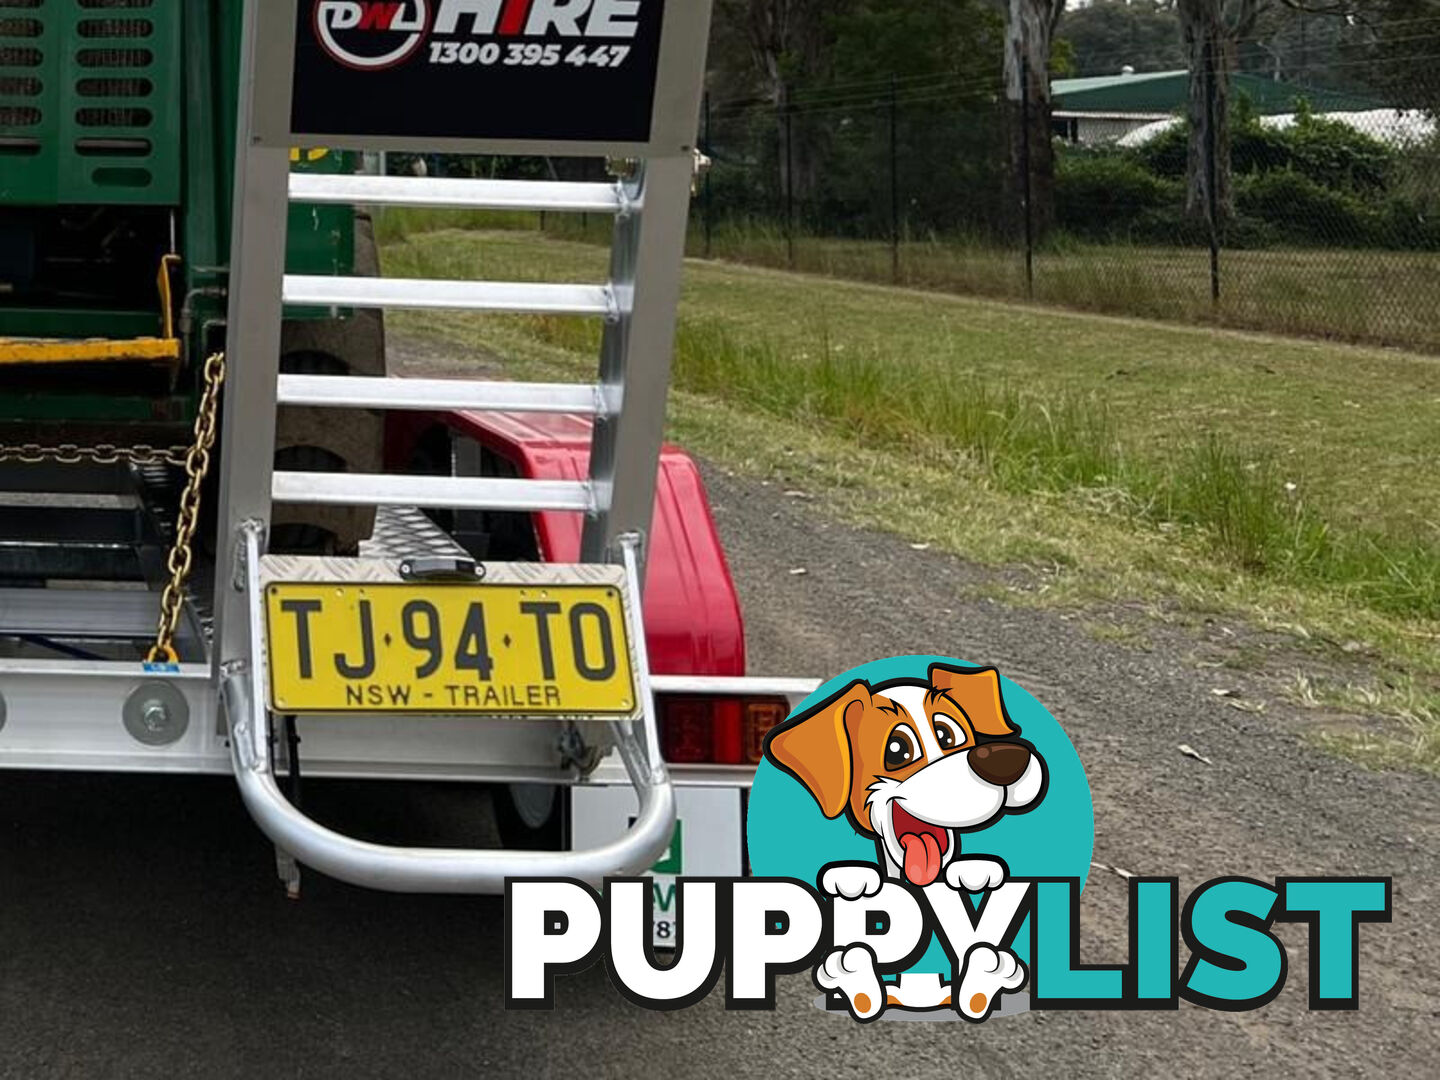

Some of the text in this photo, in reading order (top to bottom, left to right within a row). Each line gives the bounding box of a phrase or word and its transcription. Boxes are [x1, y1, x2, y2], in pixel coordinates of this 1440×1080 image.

[429, 42, 631, 68] 1300 395 447
[346, 685, 411, 705] NSW
[444, 685, 561, 707] TRAILER
